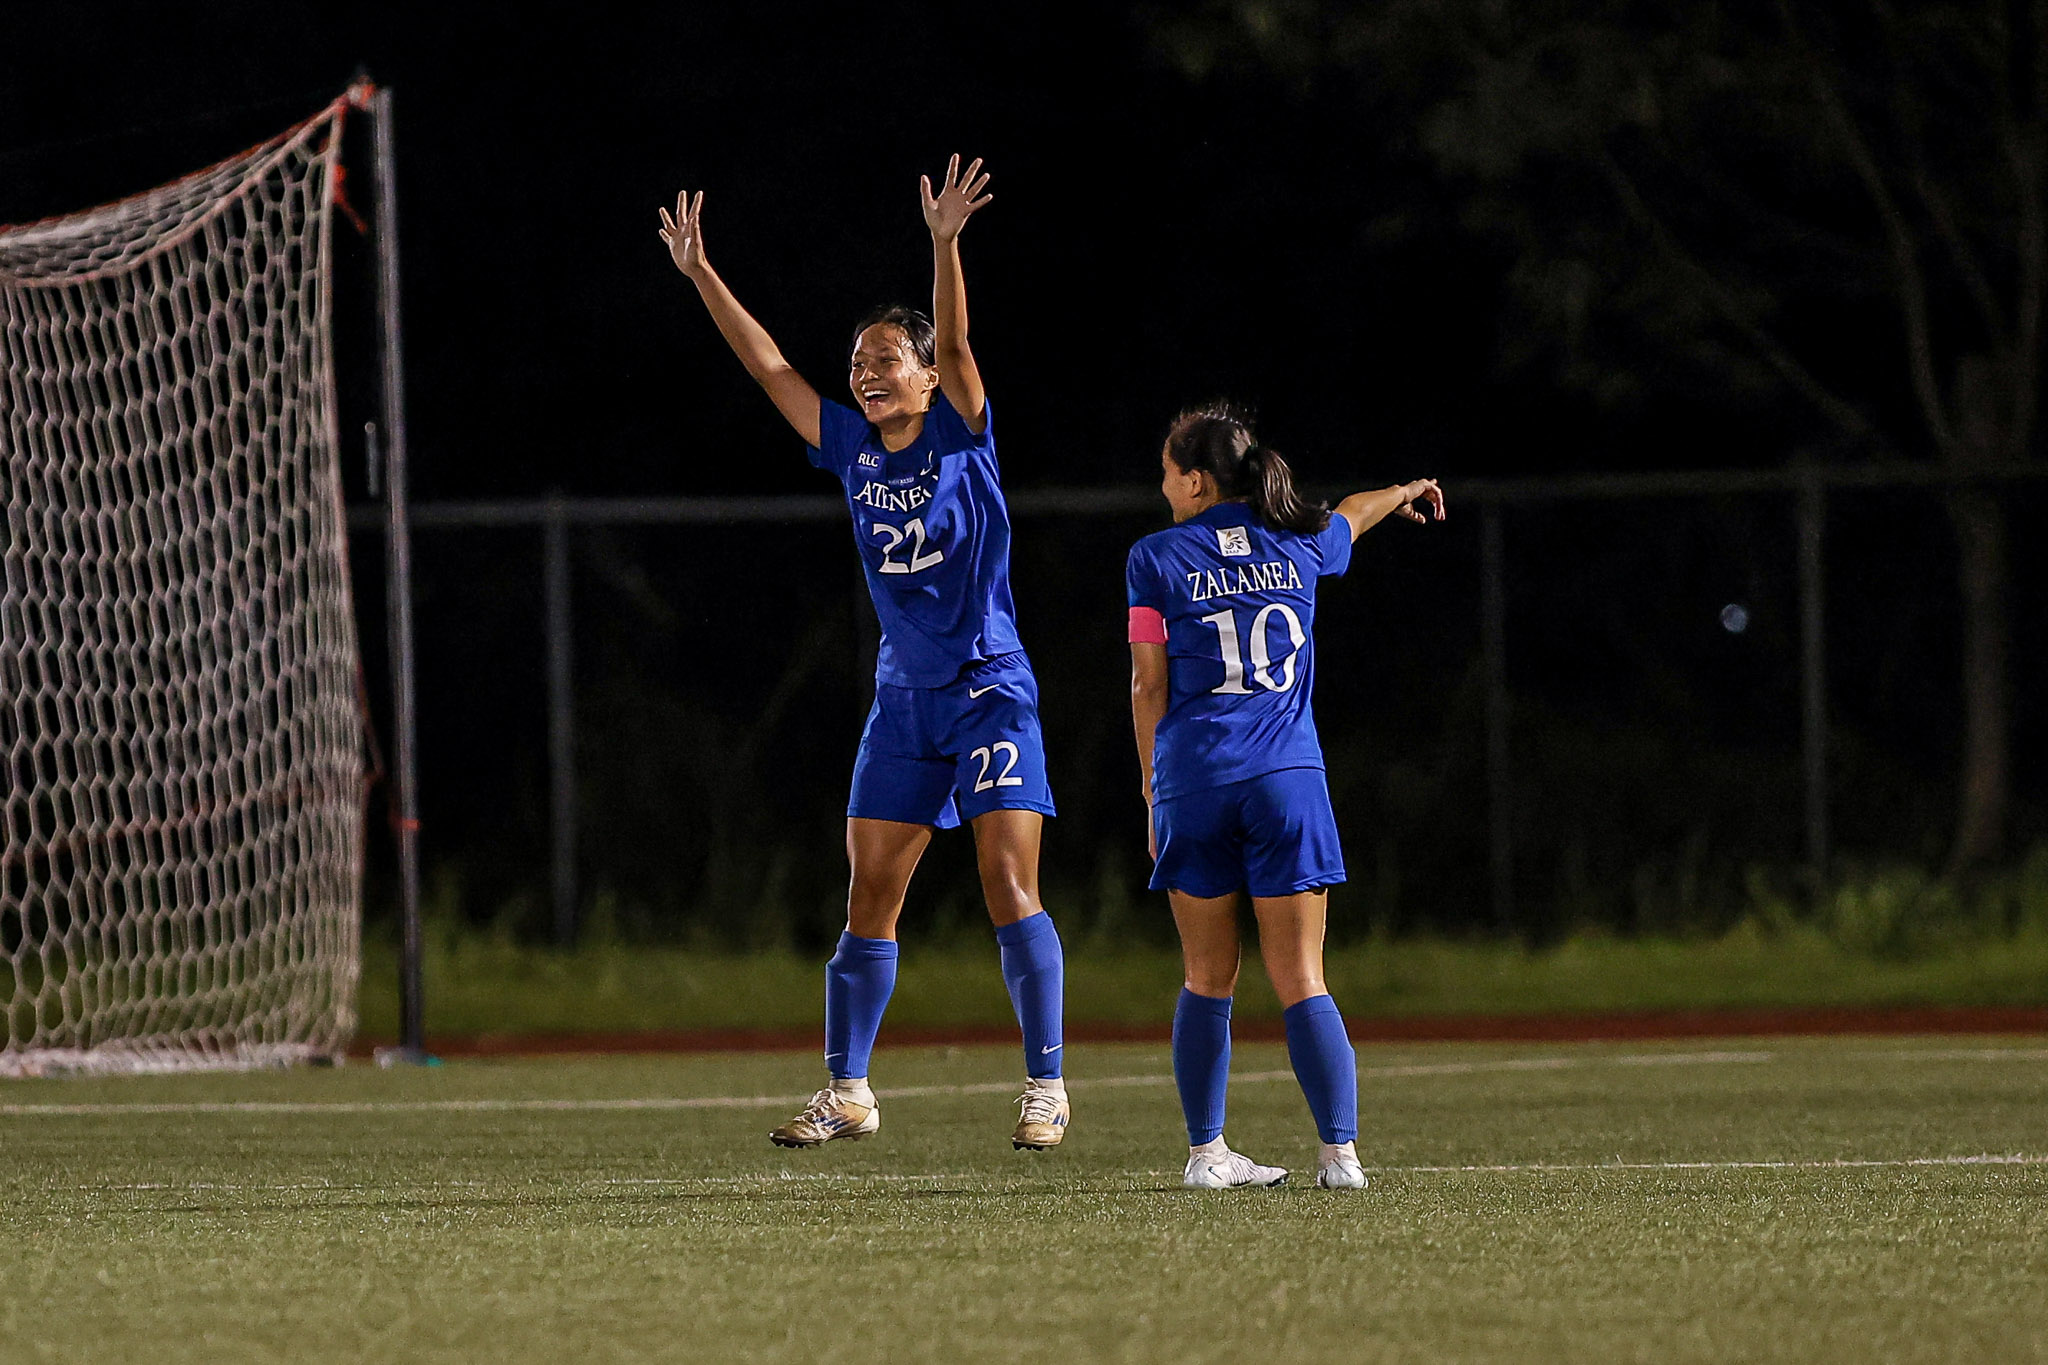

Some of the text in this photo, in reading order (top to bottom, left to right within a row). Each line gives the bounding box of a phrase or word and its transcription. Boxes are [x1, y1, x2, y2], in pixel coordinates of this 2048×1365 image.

[858, 453, 880, 467] RLC
[873, 518, 944, 573] 22
[1187, 560, 1303, 602] ZALAMEA
[1202, 603, 1306, 694] 10
[970, 741, 1023, 793] 22
